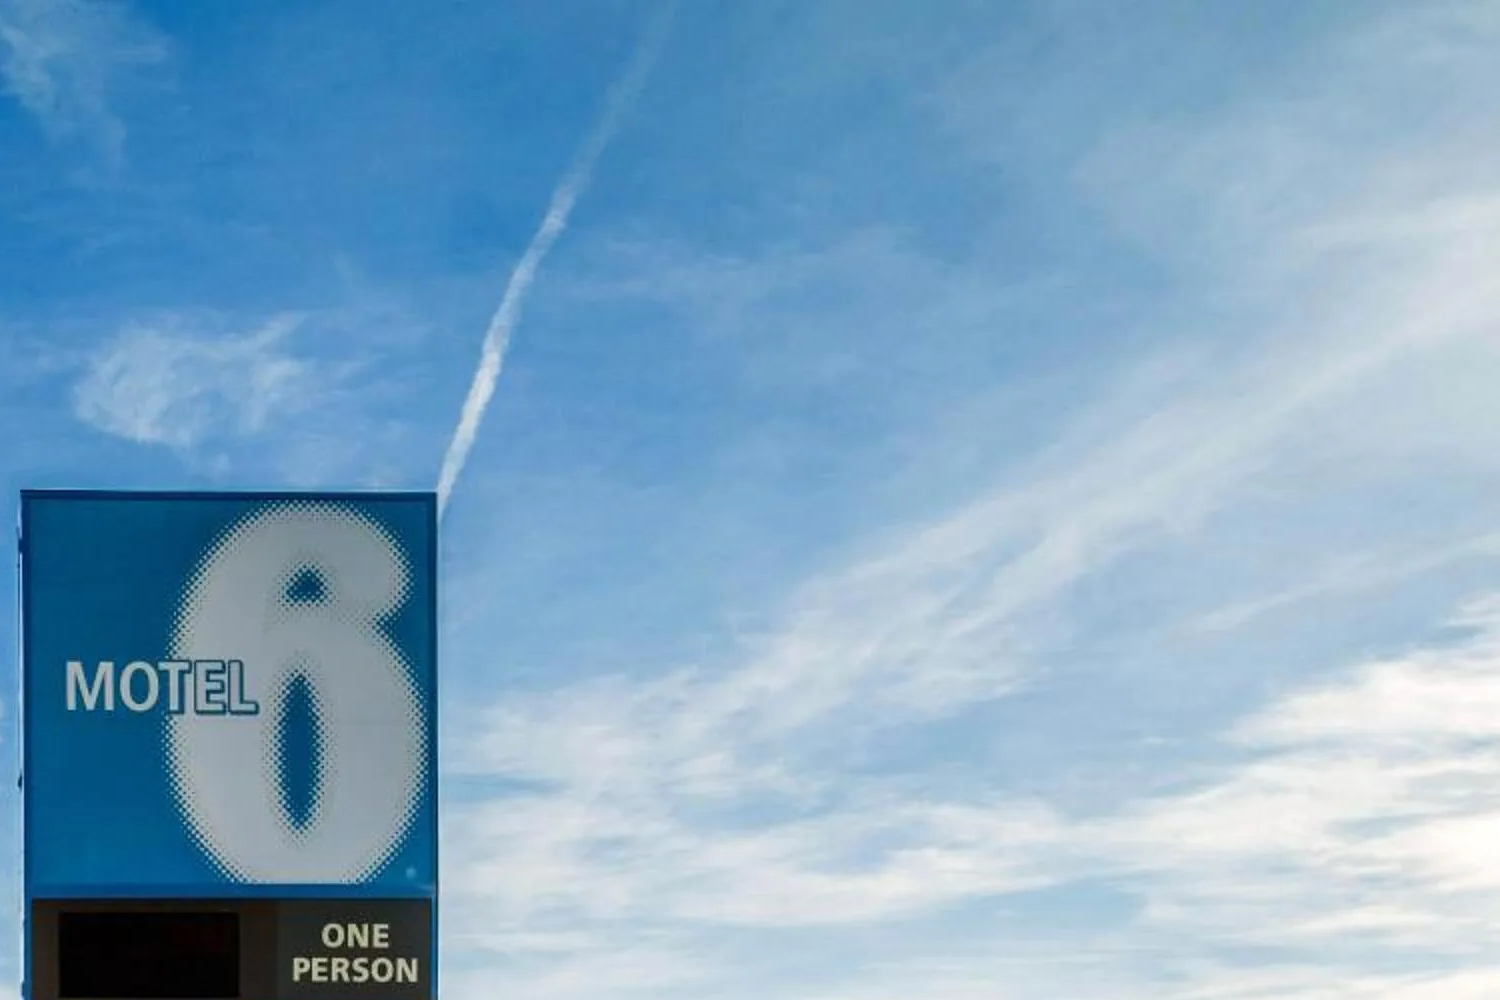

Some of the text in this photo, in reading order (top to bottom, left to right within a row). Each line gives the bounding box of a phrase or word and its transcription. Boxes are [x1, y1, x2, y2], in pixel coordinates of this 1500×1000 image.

[65, 500, 430, 884] MOTEL 6
[322, 923, 389, 949] ONE
[292, 957, 419, 983] PERSON
